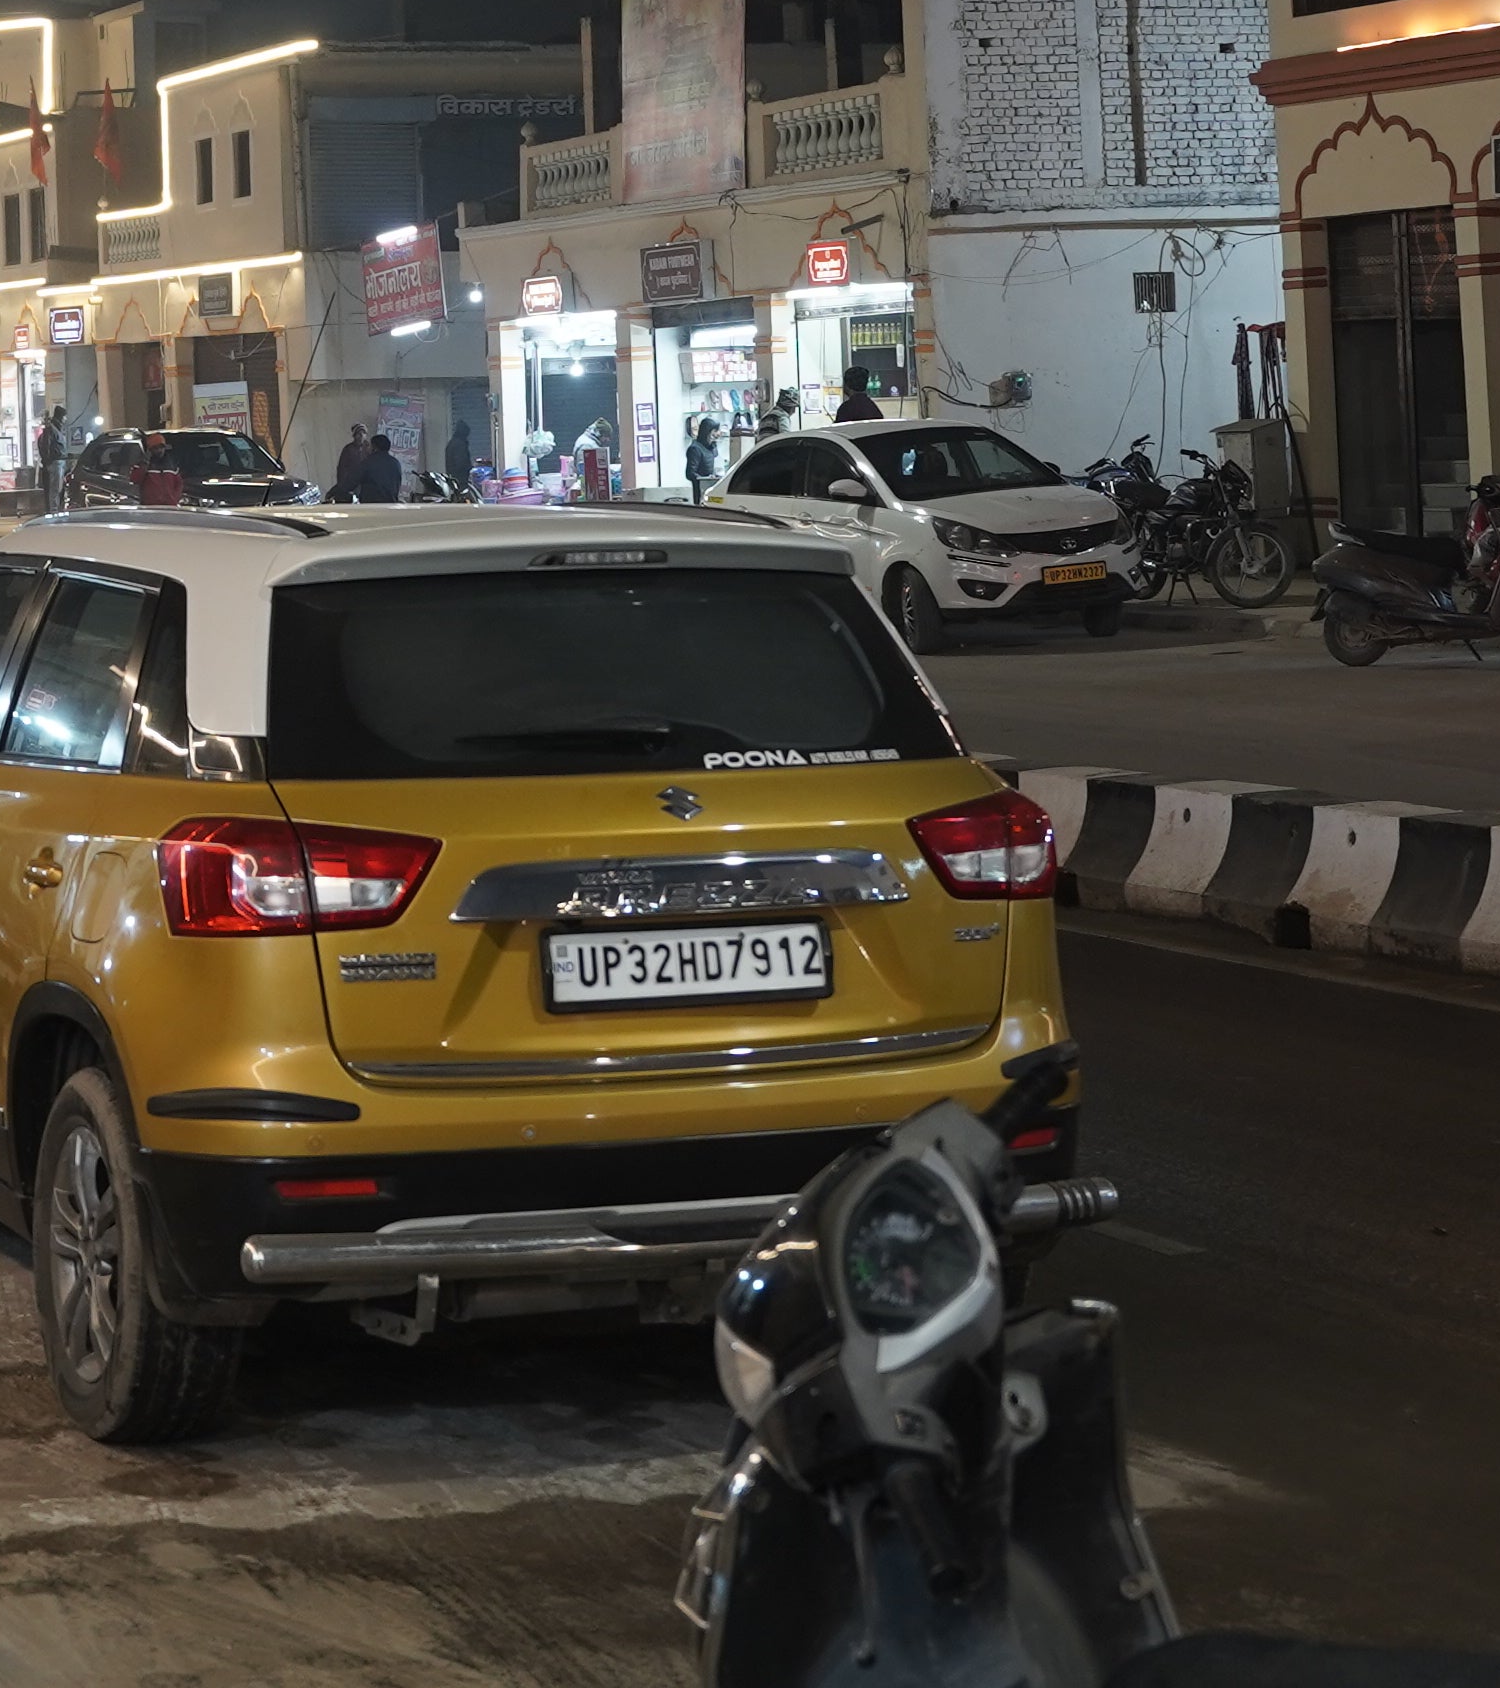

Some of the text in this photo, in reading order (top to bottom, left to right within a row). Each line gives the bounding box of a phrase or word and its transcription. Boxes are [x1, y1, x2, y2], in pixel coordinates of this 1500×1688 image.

[437, 94, 576, 117] विकास ट्रेडर्स
[366, 261, 422, 299] भोजनालय
[703, 749, 808, 770] POONA
[577, 935, 823, 988] UP32HD7912
